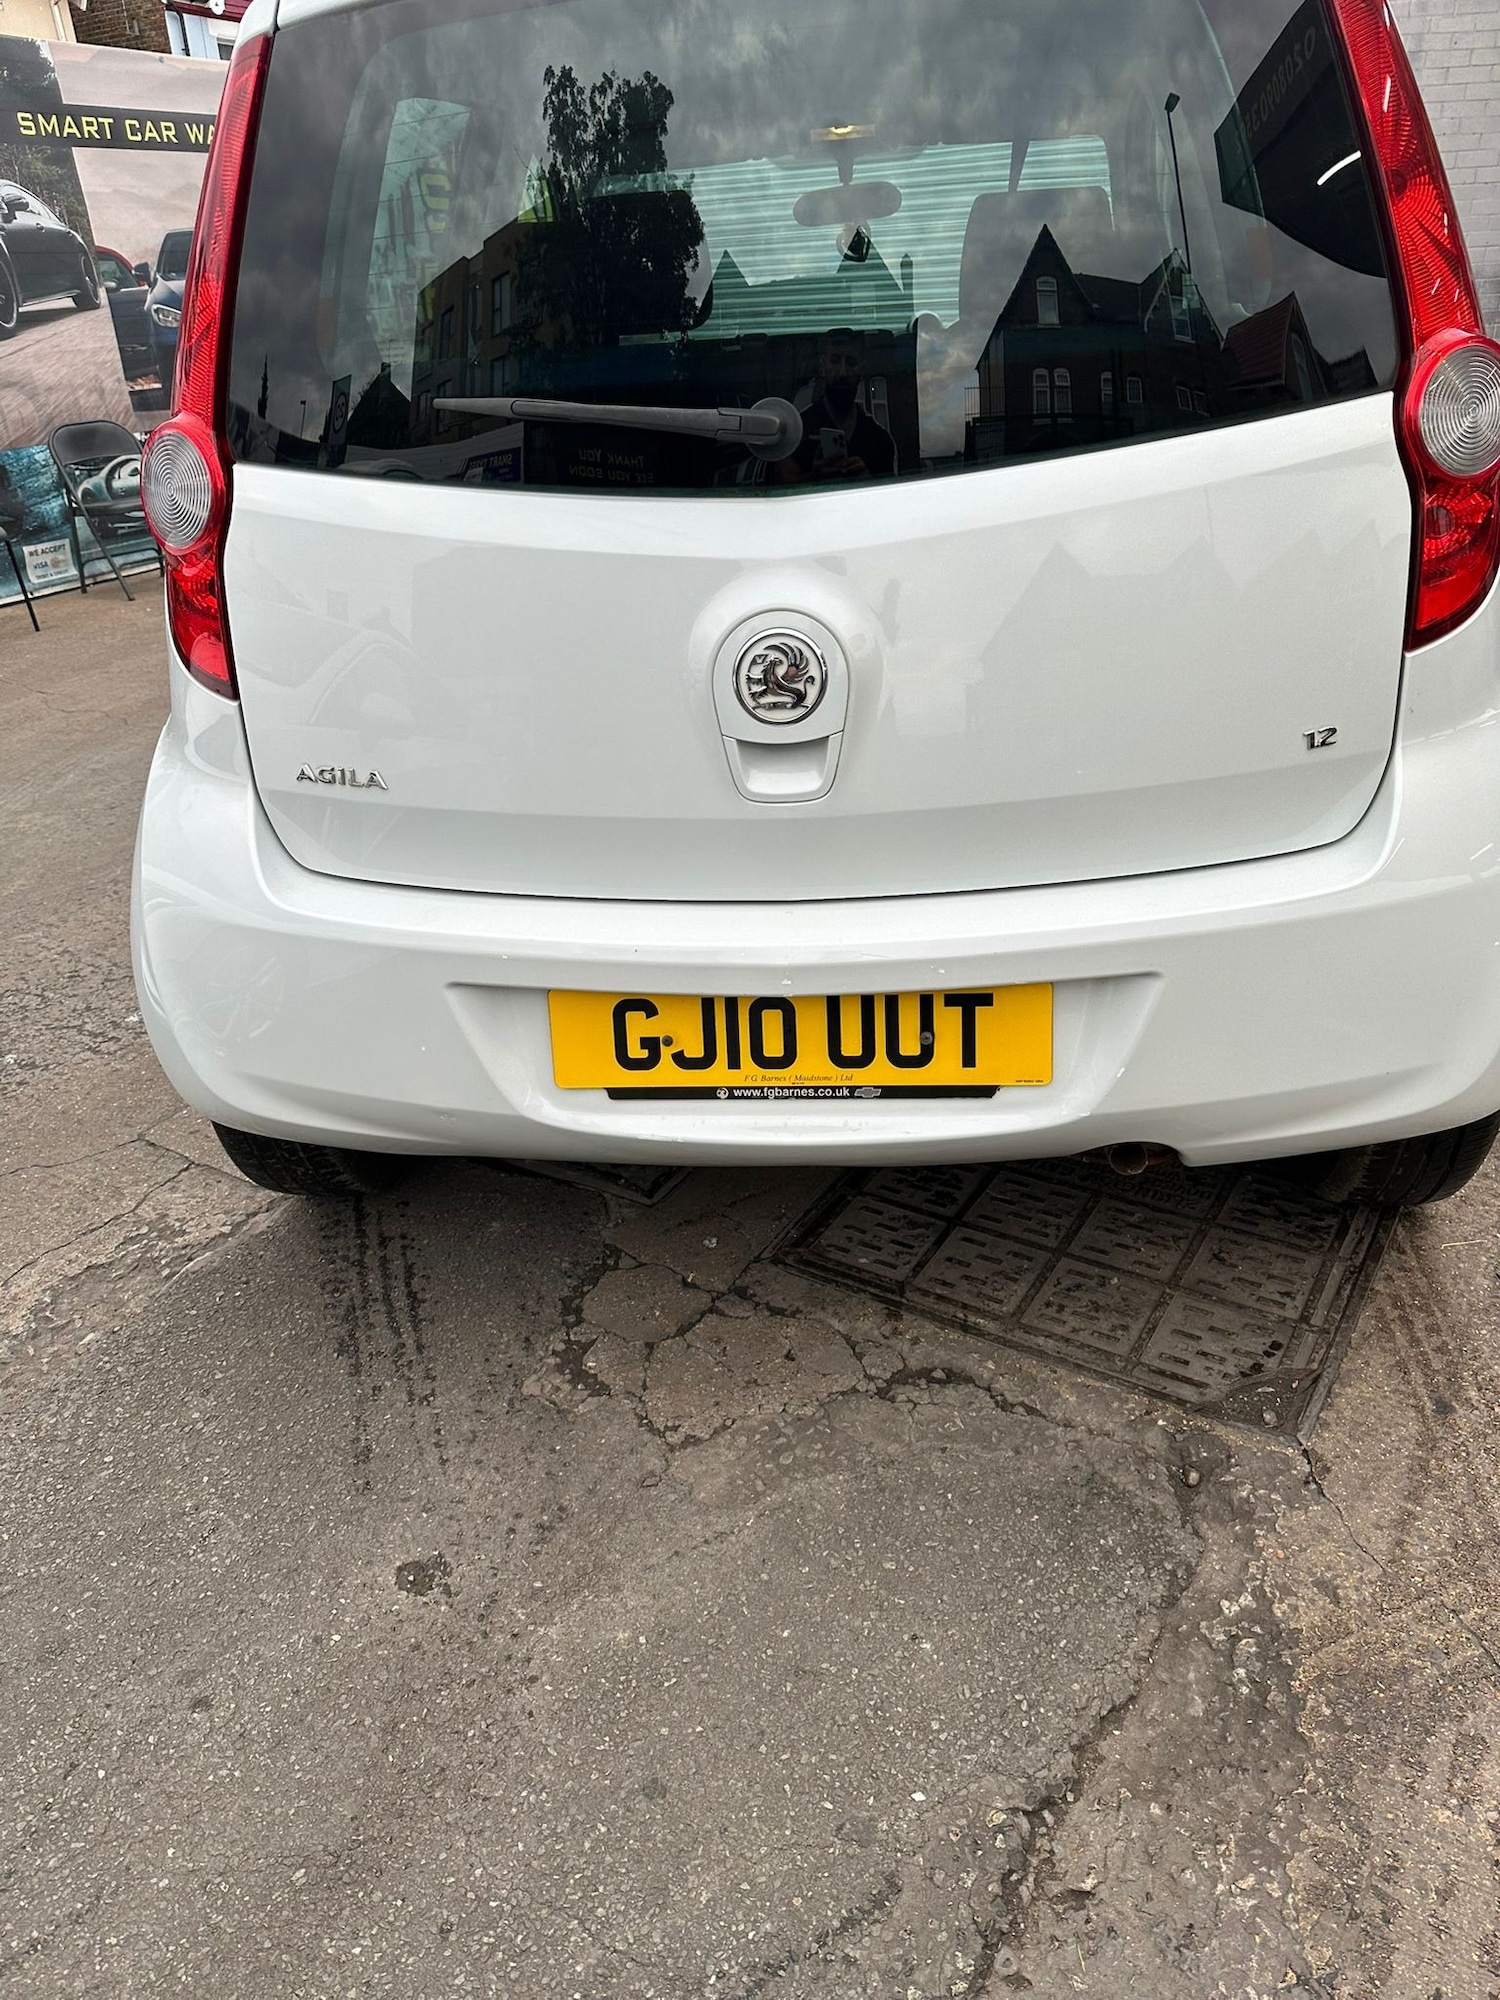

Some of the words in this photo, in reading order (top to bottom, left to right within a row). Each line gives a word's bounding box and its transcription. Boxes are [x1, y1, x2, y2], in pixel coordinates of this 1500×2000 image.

[16, 111, 114, 140] SMART
[124, 119, 178, 144] CAR
[28, 549, 40, 557] WE
[41, 544, 65, 554] ACCEPT
[296, 763, 388, 790] AGILA
[612, 996, 798, 1071] GJ10
[826, 992, 994, 1069] UUT
[760, 1074, 787, 1082] Barnes
[793, 1074, 833, 1082] Maidstone
[840, 1073, 853, 1081] Ltd
[734, 1087, 850, 1099] www.fgbarnes.co.uk
